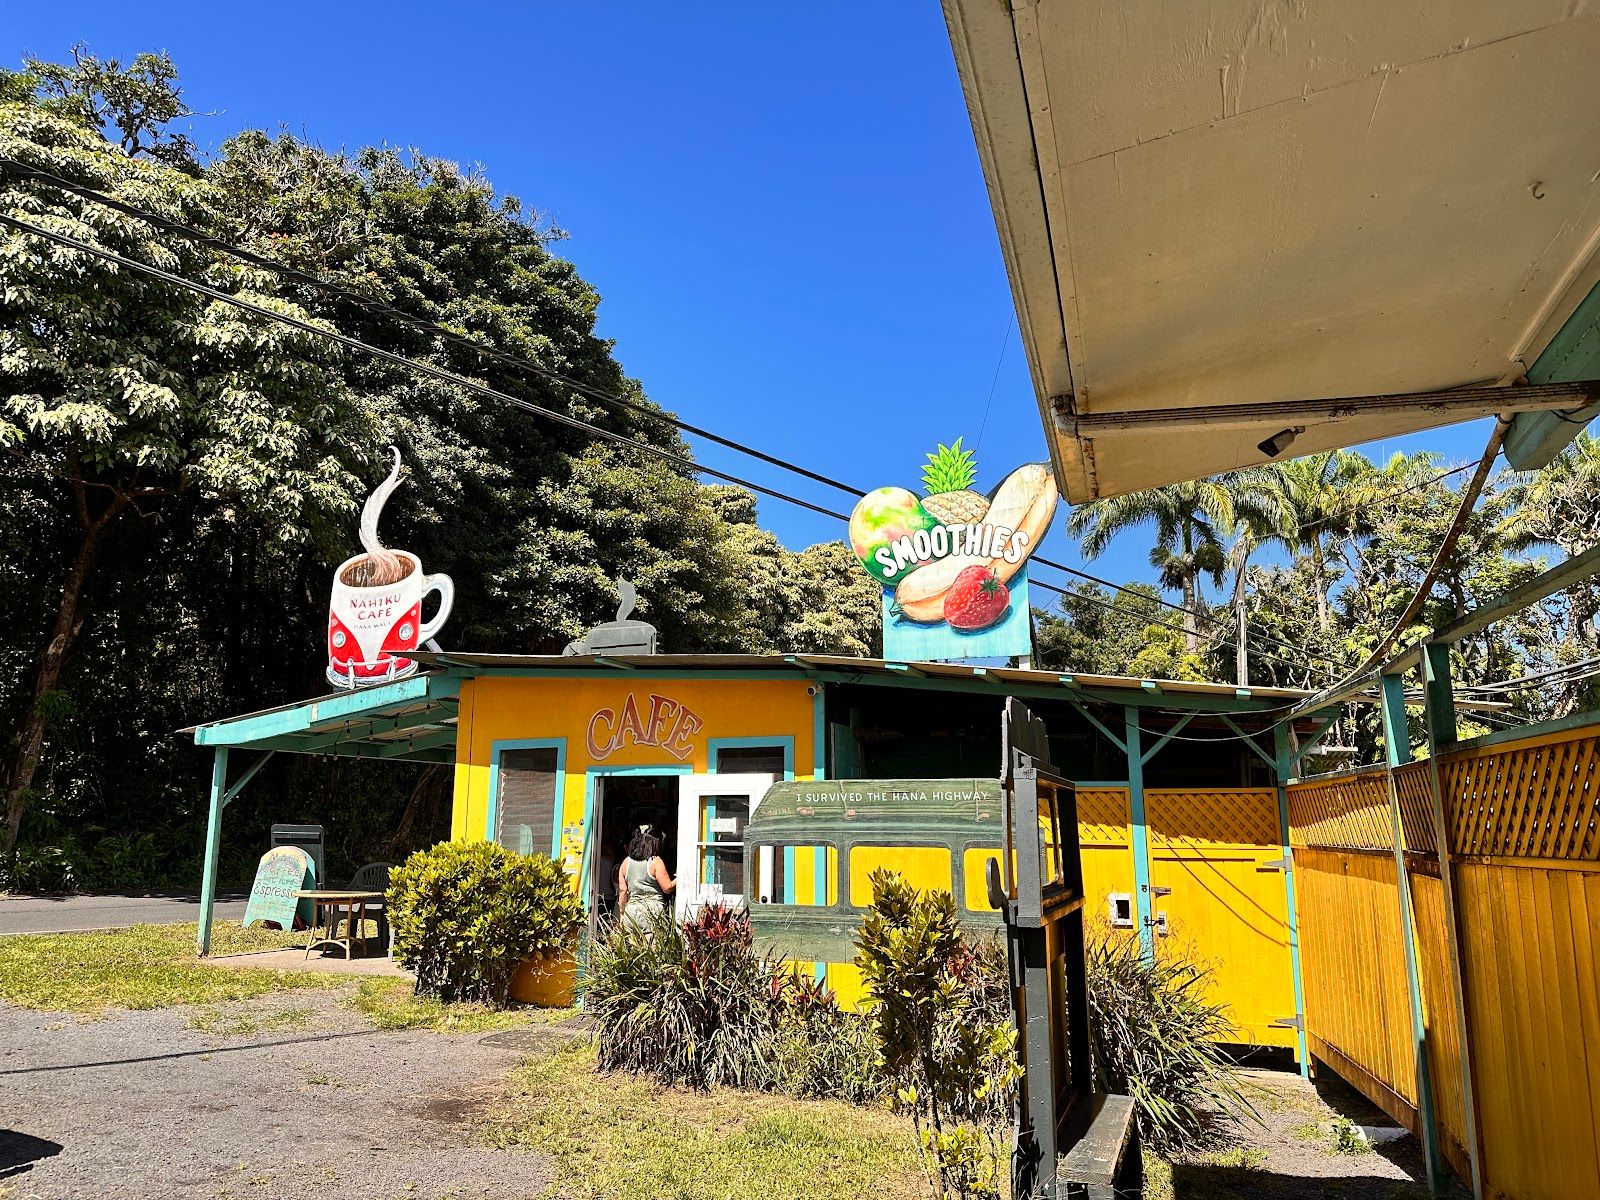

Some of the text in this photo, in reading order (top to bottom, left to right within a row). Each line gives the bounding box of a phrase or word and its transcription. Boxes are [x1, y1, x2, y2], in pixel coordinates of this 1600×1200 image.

[874, 523, 1029, 578] SMOOTHIES
[350, 593, 401, 608] NAHIKU
[358, 607, 392, 620] CAFE
[586, 692, 704, 760] CAFE
[796, 790, 988, 803] I SURVIVED THE HANA HIGHWAY
